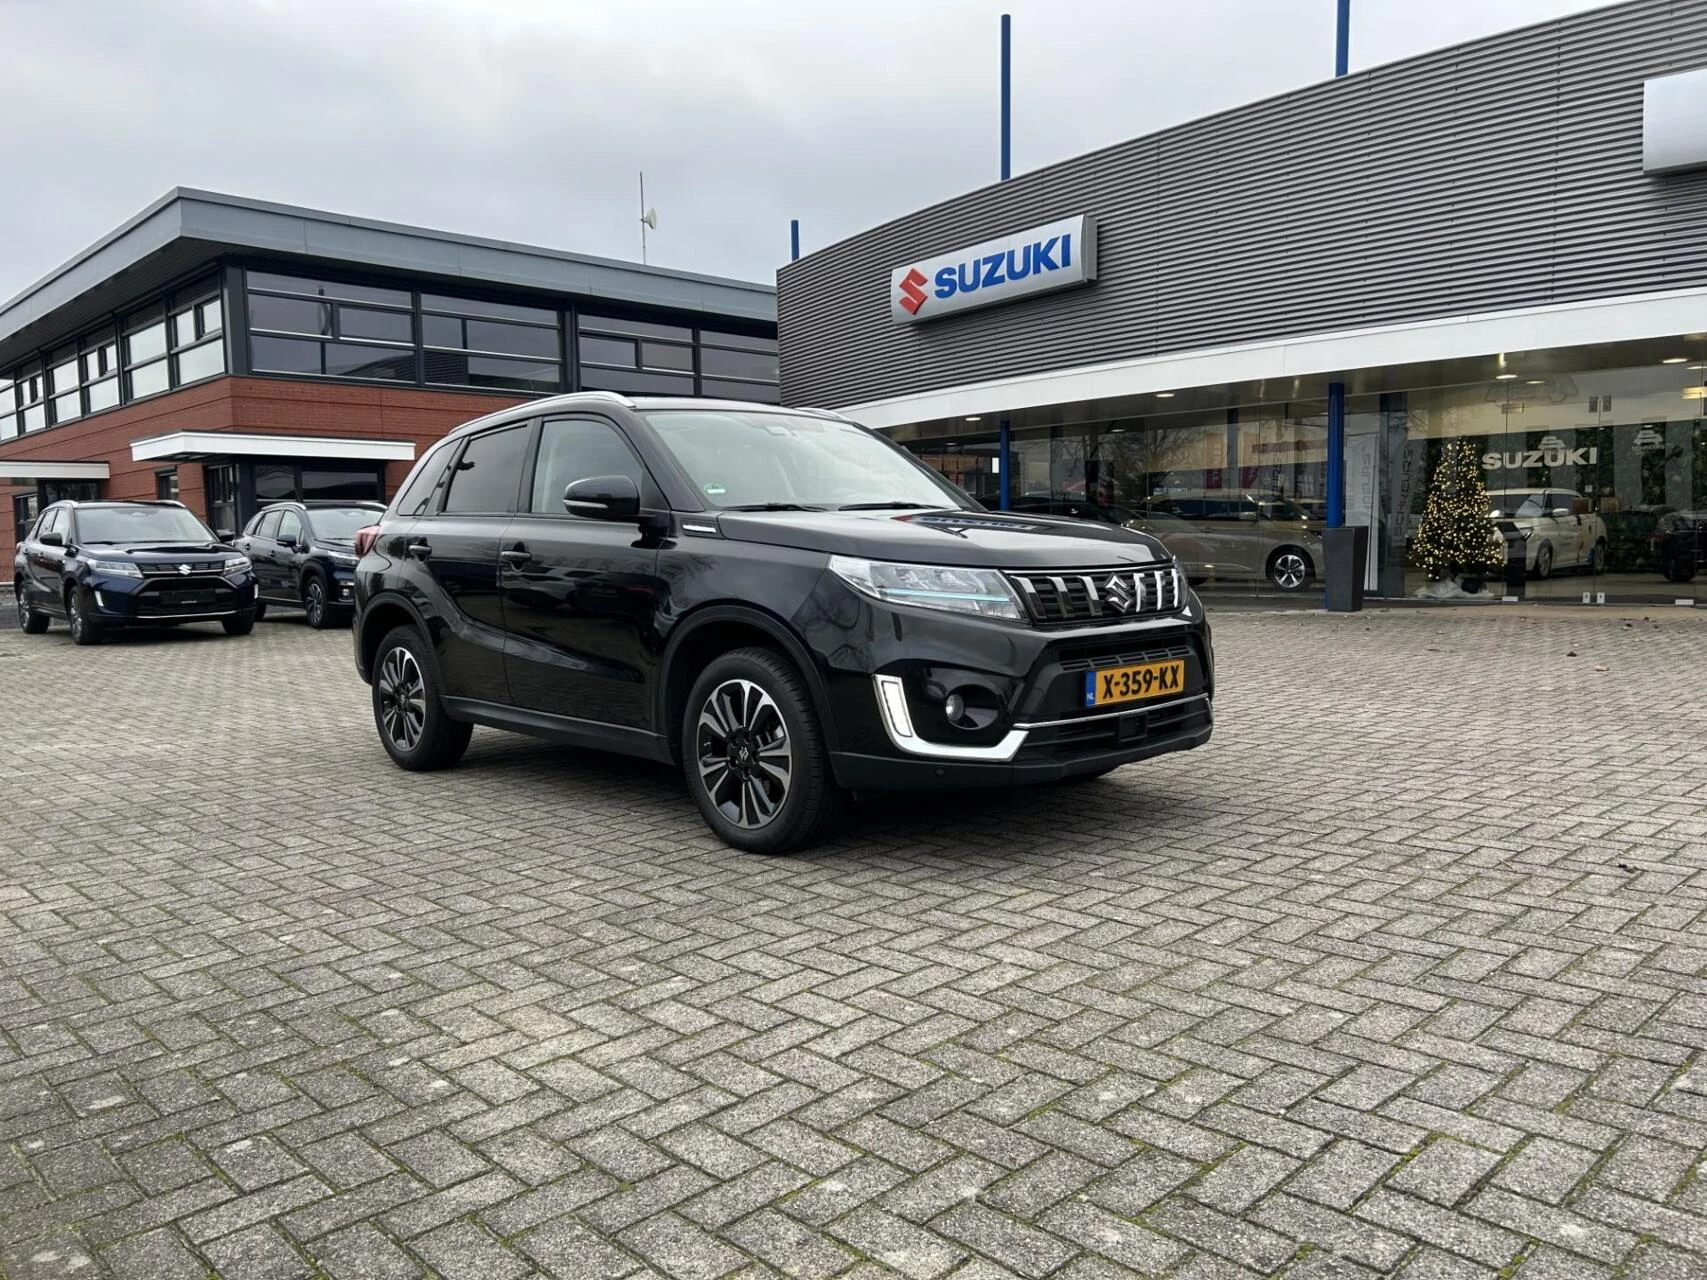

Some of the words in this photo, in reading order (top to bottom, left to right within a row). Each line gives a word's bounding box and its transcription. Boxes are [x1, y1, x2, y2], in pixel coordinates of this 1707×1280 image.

[934, 234, 1071, 299] SUZUKI
[1481, 447, 1598, 470] SUZUKI
[1103, 665, 1179, 699] X-359-KX
